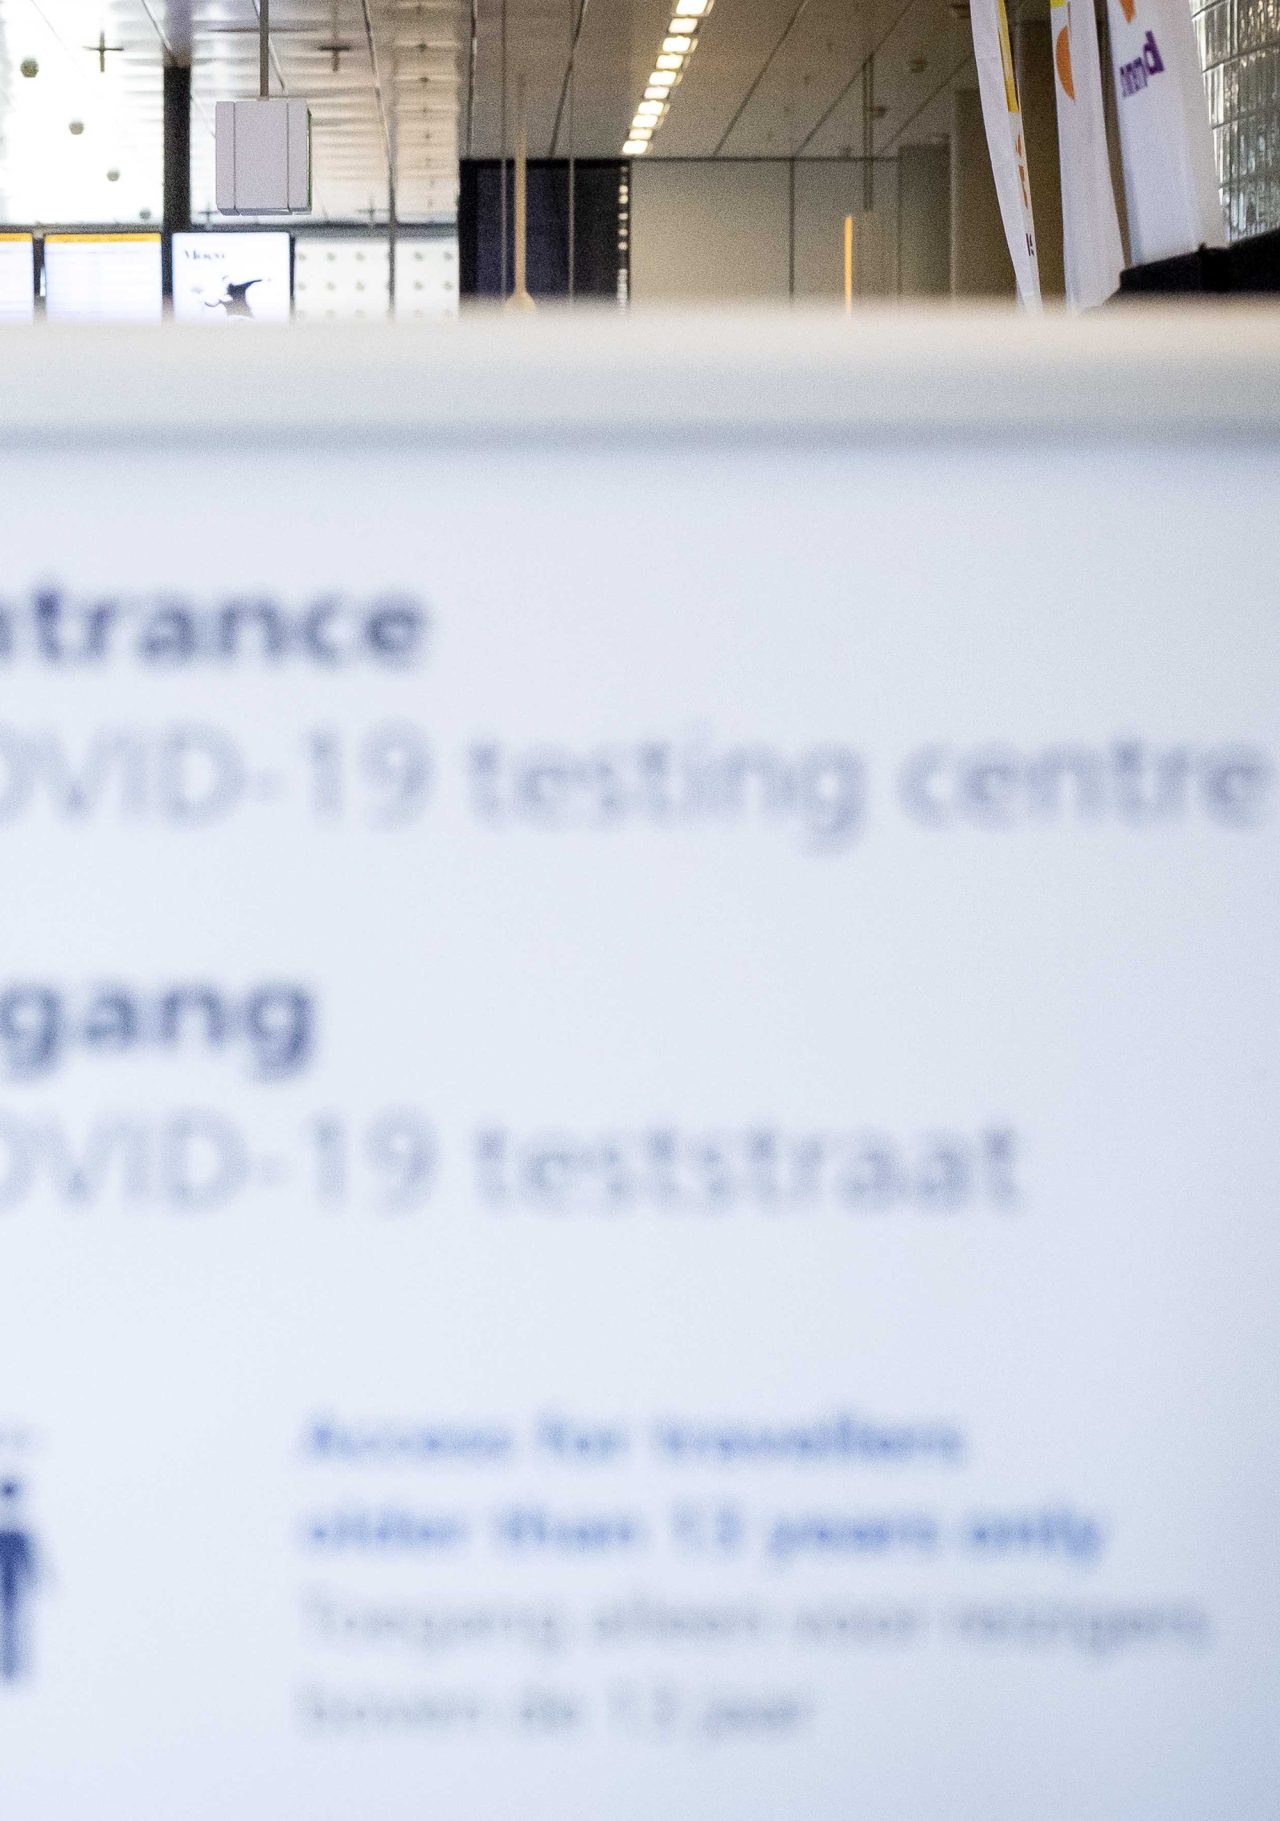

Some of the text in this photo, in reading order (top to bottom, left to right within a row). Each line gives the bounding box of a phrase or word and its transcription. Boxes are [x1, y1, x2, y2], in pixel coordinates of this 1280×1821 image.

[462, 724, 864, 852] testing
[900, 730, 1274, 828] centre
[468, 1120, 1027, 1215] teststraat
[301, 1411, 520, 1466] Access
[533, 1409, 630, 1466] for
[493, 1500, 648, 1557] than
[760, 1508, 947, 1569] years
[957, 1500, 1110, 1569] only
